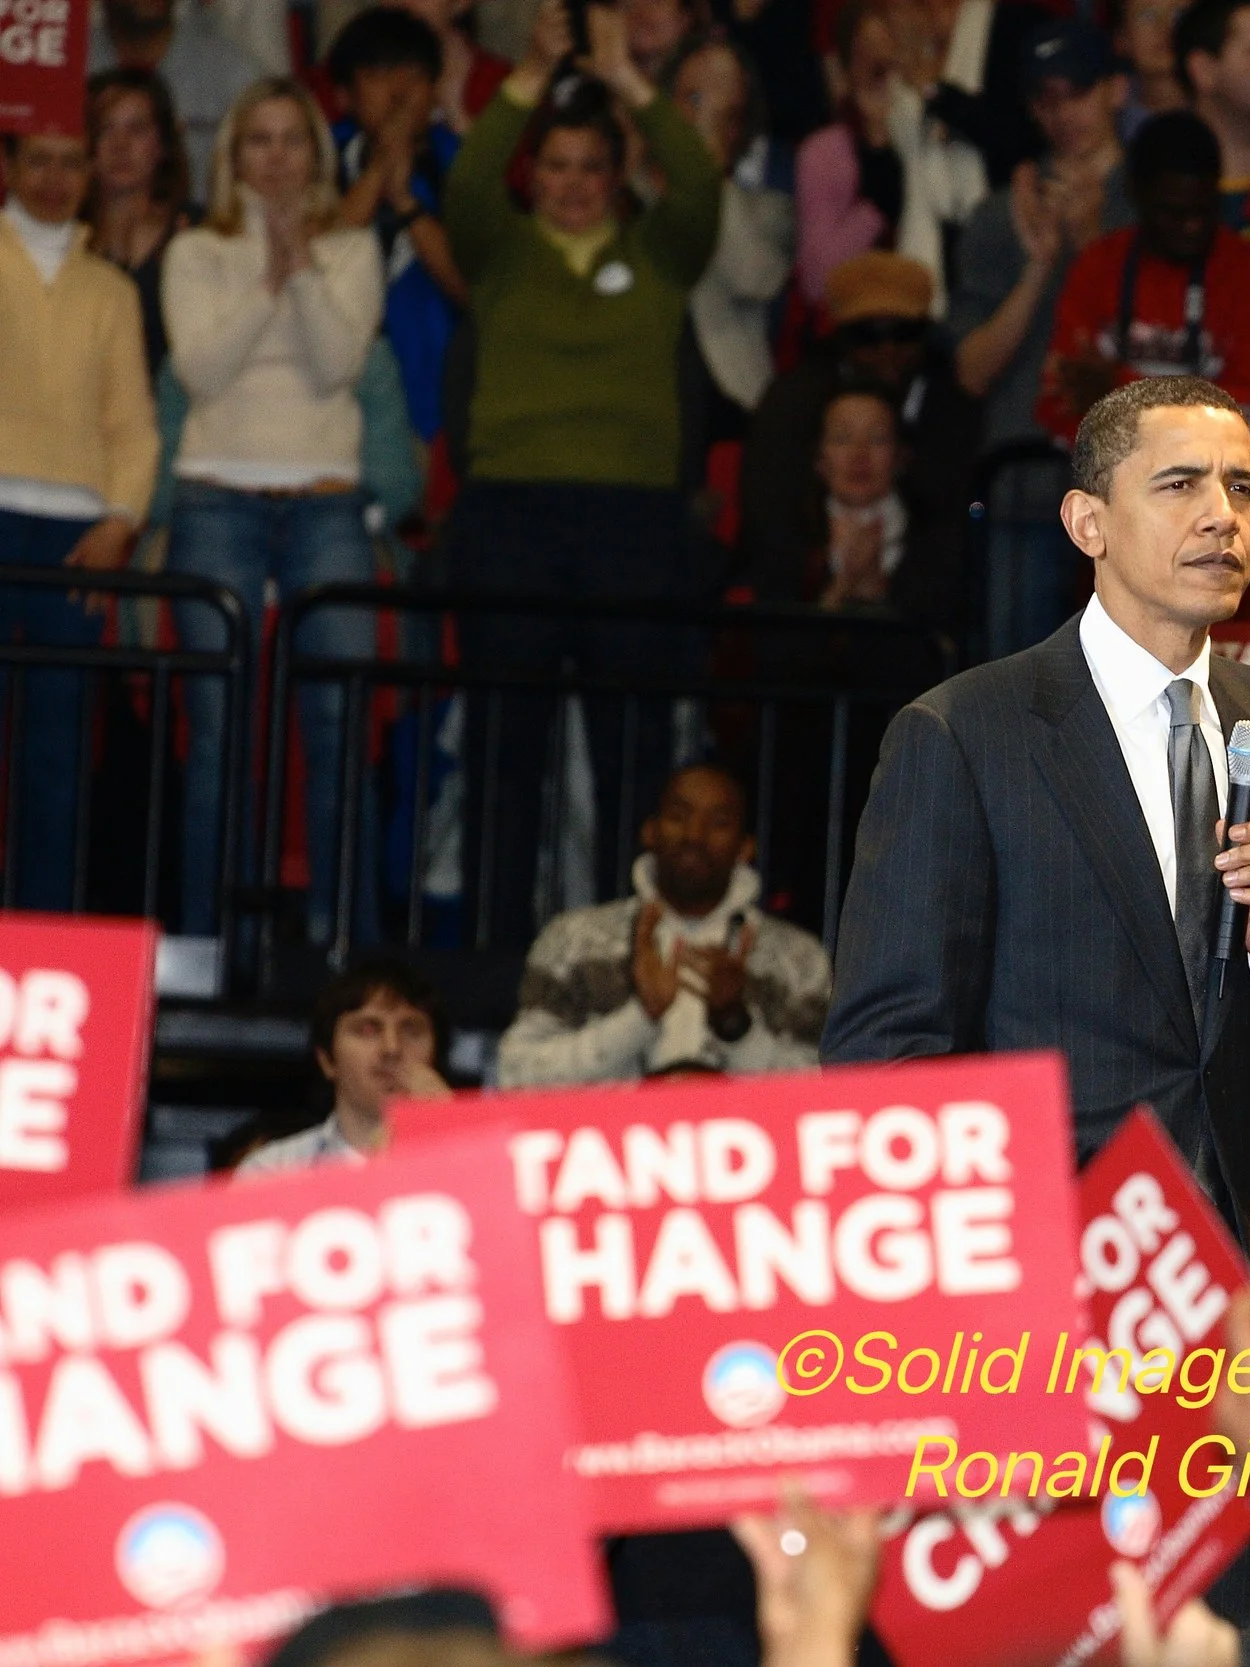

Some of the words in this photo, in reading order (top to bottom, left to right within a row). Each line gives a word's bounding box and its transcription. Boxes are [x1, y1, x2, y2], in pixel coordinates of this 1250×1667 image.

[509, 1116, 777, 1216] TAND
[796, 1100, 1013, 1197] FOR
[207, 1191, 479, 1328] FOR
[538, 1186, 1022, 1326] HANGE
[1084, 1171, 1180, 1291] OR
